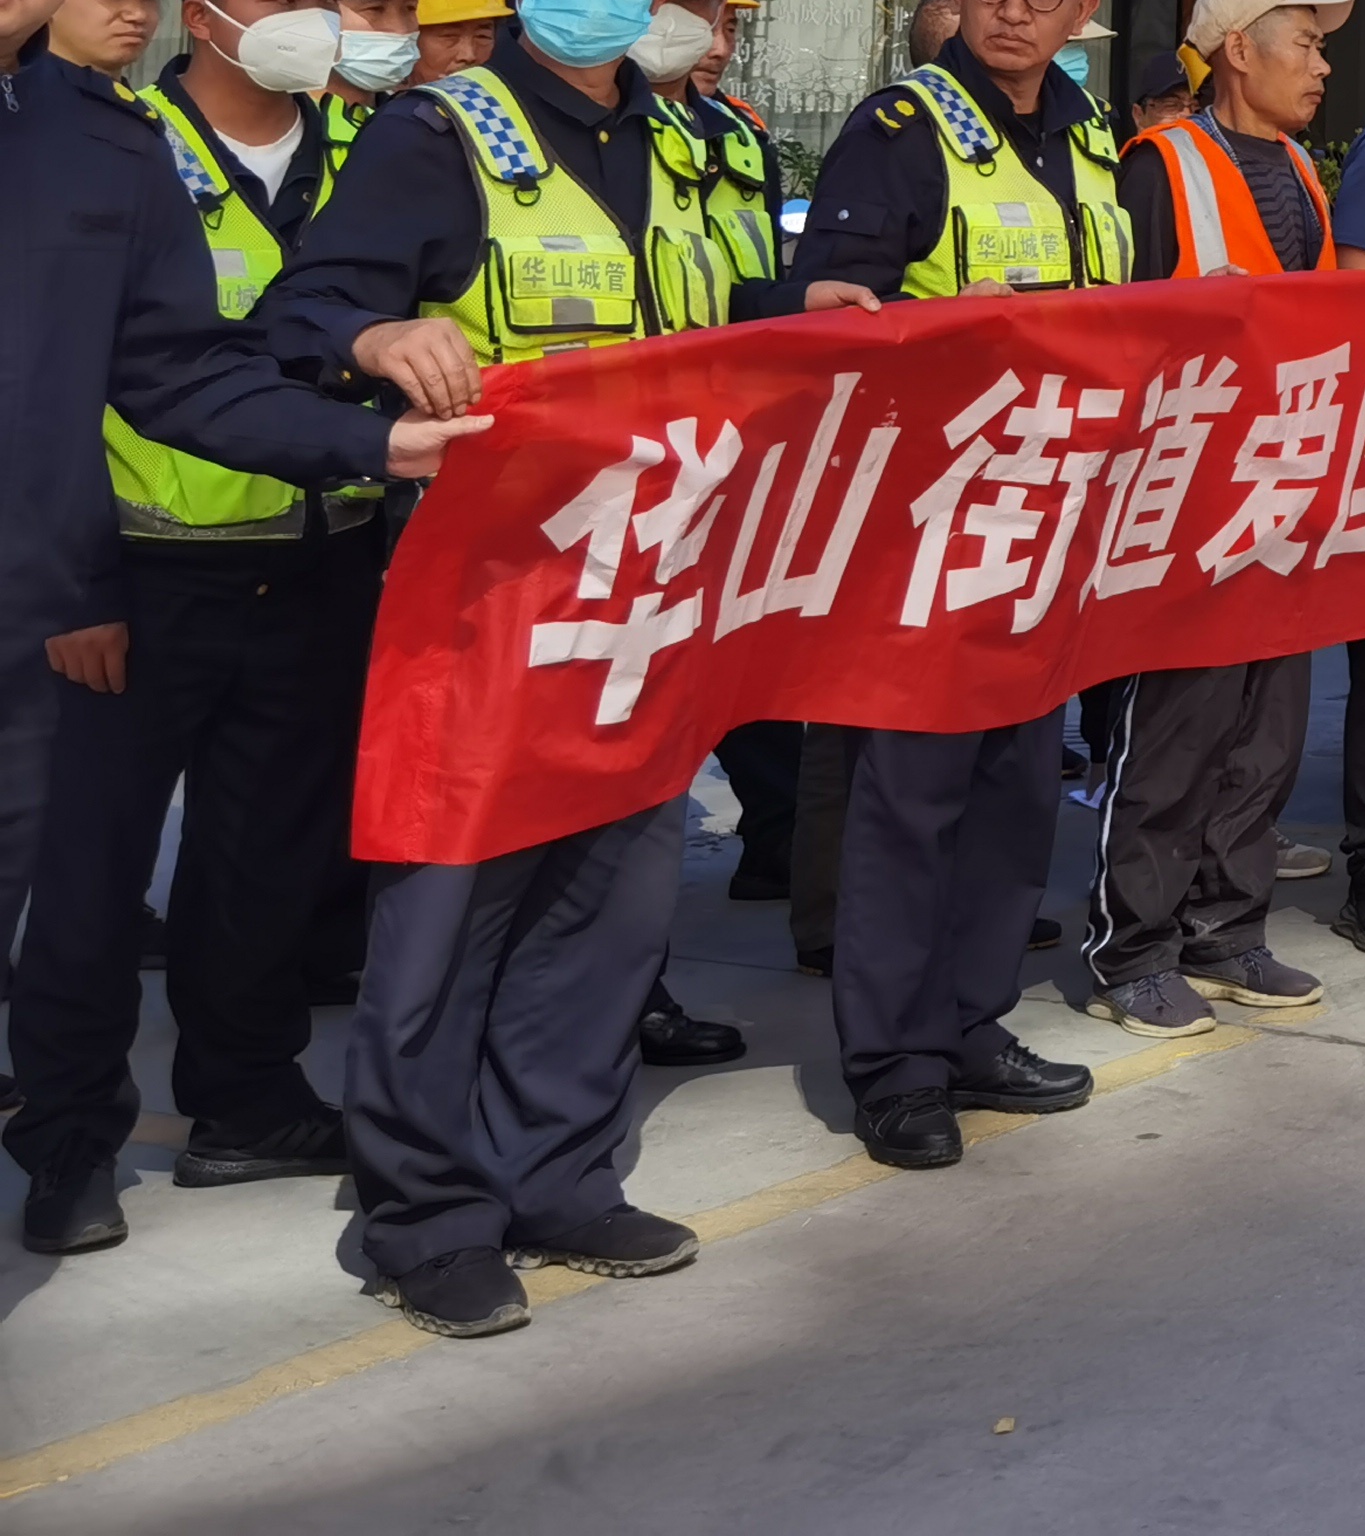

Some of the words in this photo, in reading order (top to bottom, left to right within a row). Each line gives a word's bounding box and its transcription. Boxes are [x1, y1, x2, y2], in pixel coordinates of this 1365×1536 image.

[976, 231, 1061, 262] 华山城管
[521, 256, 628, 293] 华山城管
